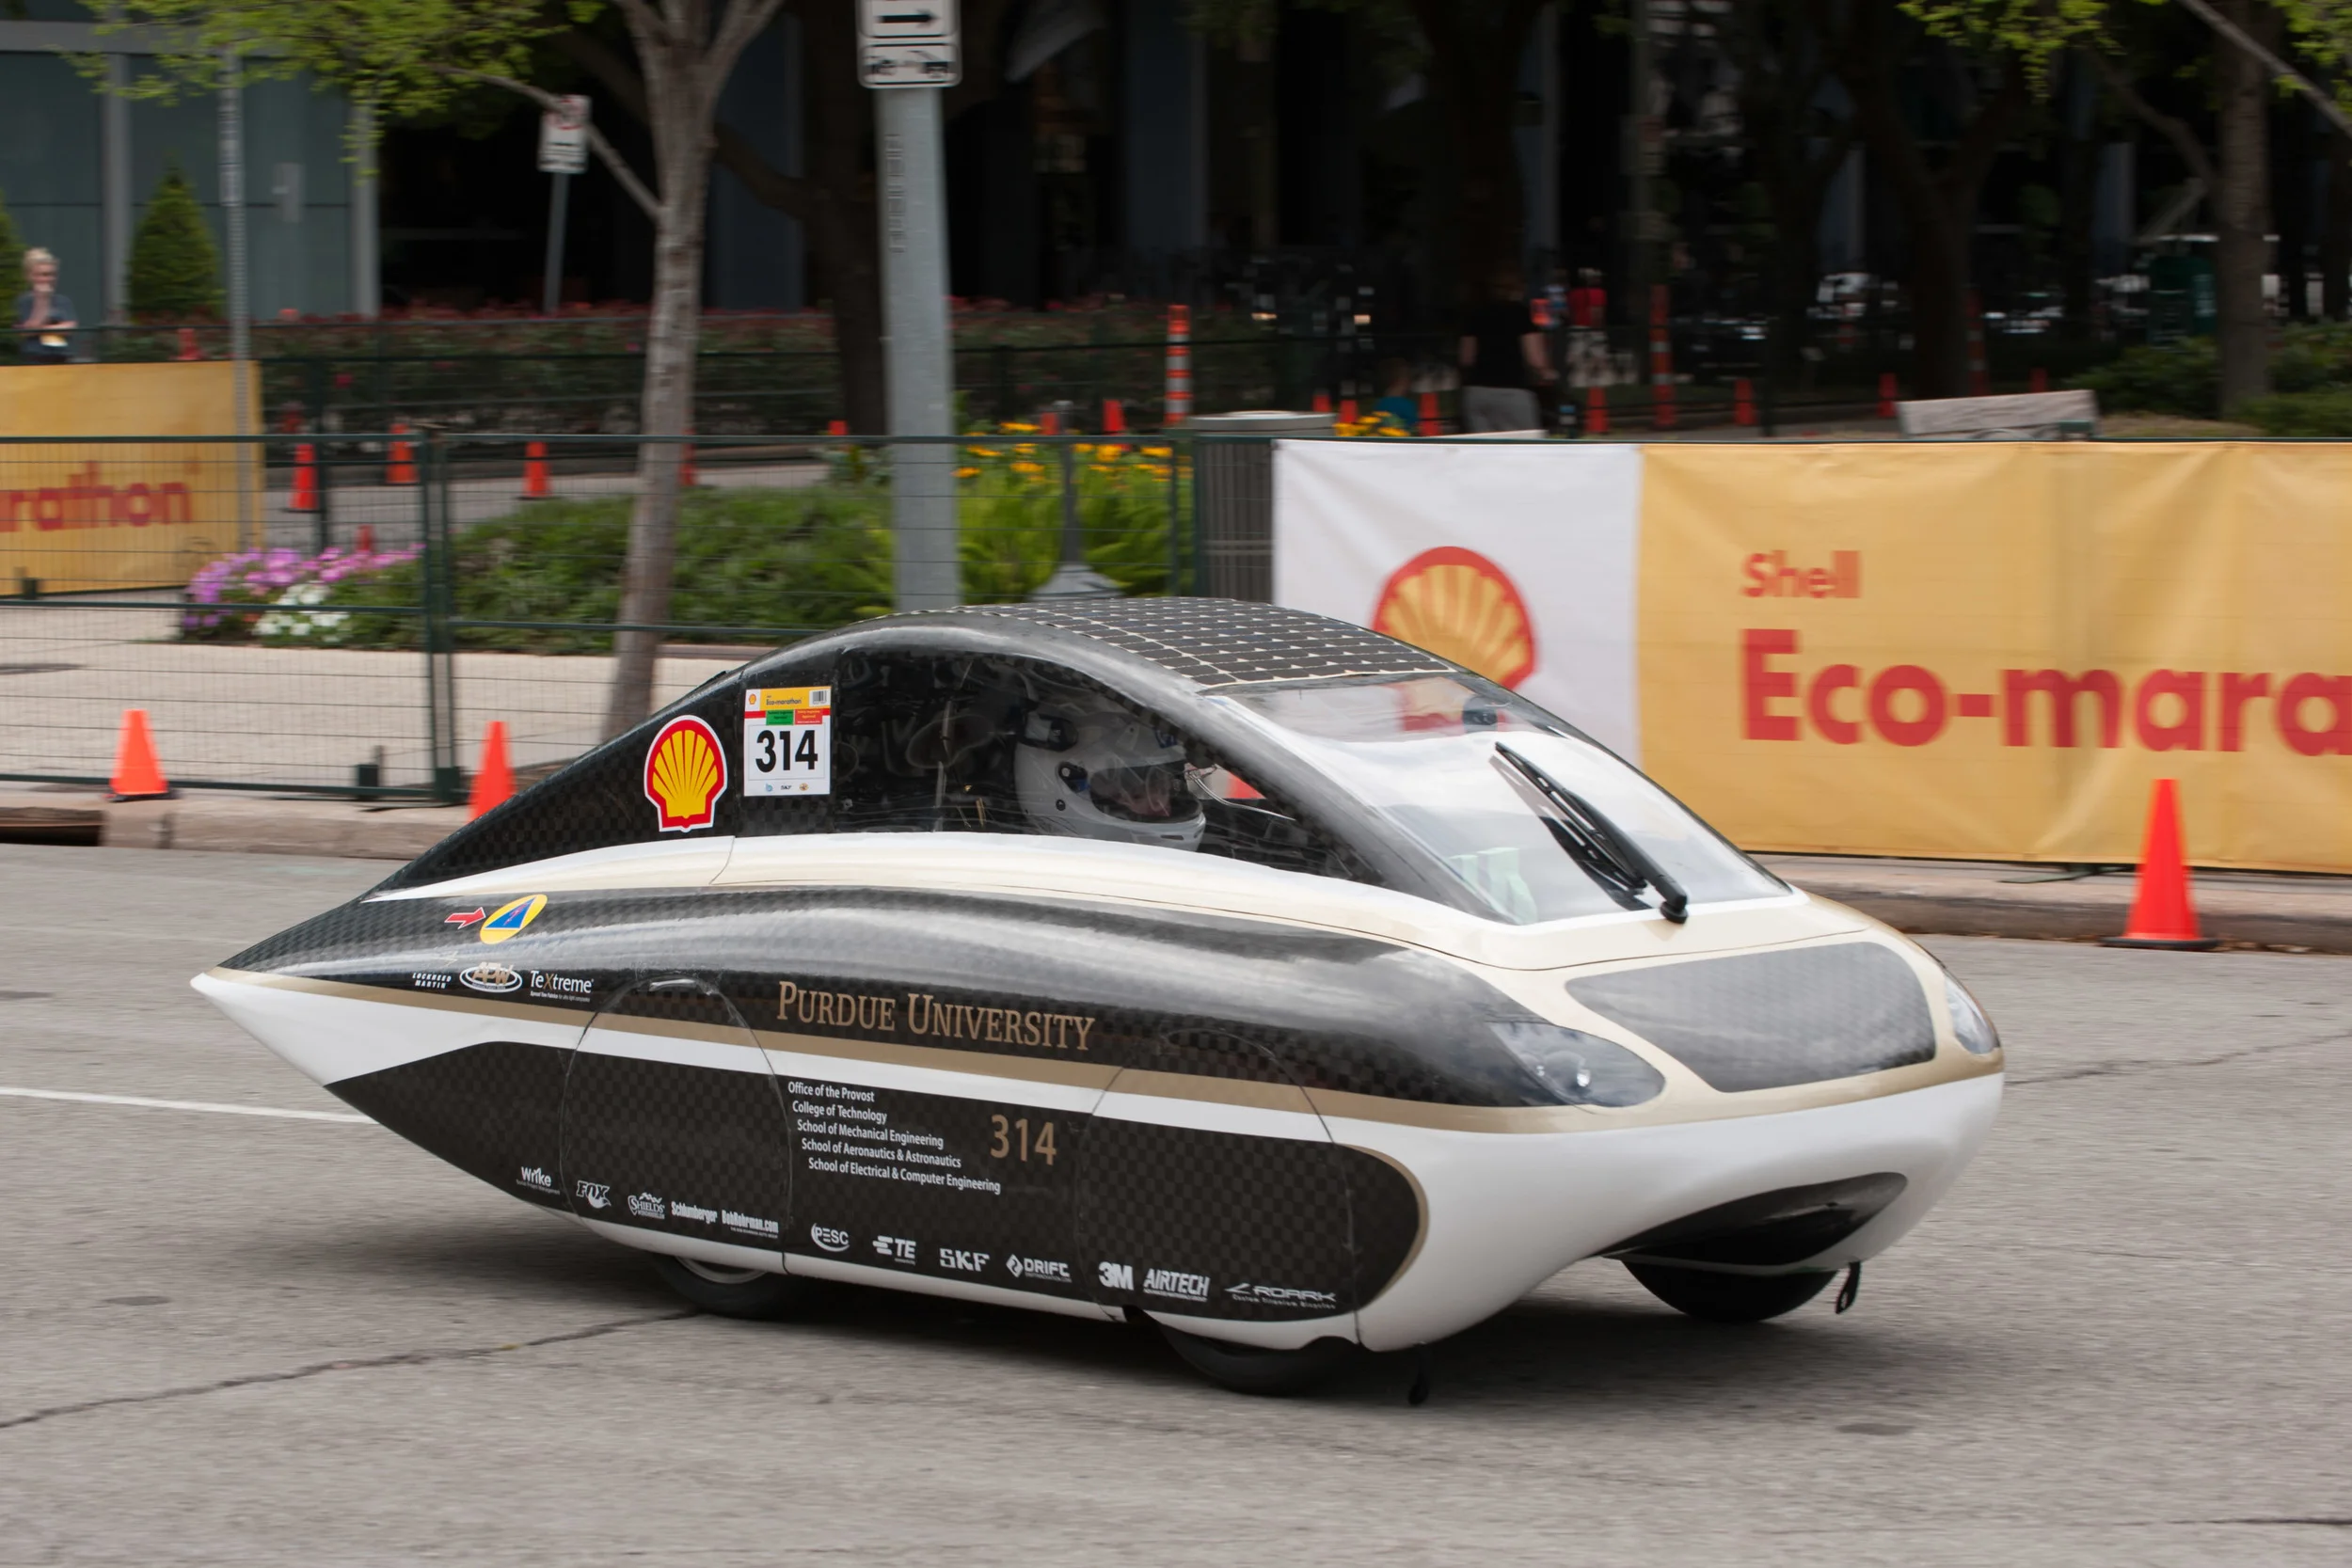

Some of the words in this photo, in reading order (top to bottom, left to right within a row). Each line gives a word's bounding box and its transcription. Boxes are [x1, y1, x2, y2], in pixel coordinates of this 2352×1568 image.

[1740, 549, 1862, 598] Shell
[1740, 627, 2352, 756] Eco-mara
[755, 730, 818, 773] 314
[412, 973, 452, 983] LOCKHEED
[414, 979, 447, 989] MARTIN
[530, 970, 594, 993] TeXtreme
[776, 980, 897, 1031] PURDUE
[907, 992, 1096, 1051] UNIVERSITY
[787, 1082, 814, 1096] Office
[815, 1085, 824, 1097] of
[825, 1085, 840, 1099] the
[841, 1087, 875, 1102] Provost
[792, 1101, 825, 1117] College
[826, 1103, 835, 1117] of
[837, 1104, 887, 1125] Technology
[797, 1119, 826, 1133] School
[828, 1122, 838, 1134] of
[839, 1123, 888, 1141] Mechanical
[890, 1129, 944, 1150] Engineering
[990, 1114, 1057, 1165] 314
[802, 1137, 831, 1153] School
[833, 1141, 842, 1154] of
[843, 1143, 896, 1161] Aeronautics
[897, 1148, 904, 1162] &
[905, 1149, 961, 1168] Astronautics
[520, 1166, 551, 1187] Wrike
[808, 1157, 838, 1173] School
[839, 1161, 850, 1174] of
[850, 1163, 890, 1180] Electrical
[892, 1167, 899, 1180] &
[900, 1168, 946, 1187] Computer
[946, 1174, 1001, 1196] Engineering
[576, 1180, 610, 1200] FOX
[671, 1201, 718, 1224] Schlumberger
[815, 1227, 850, 1245] PESC
[940, 1248, 990, 1272] SKF
[1098, 1261, 1134, 1291] 3M
[1142, 1268, 1210, 1297] AIRTECH
